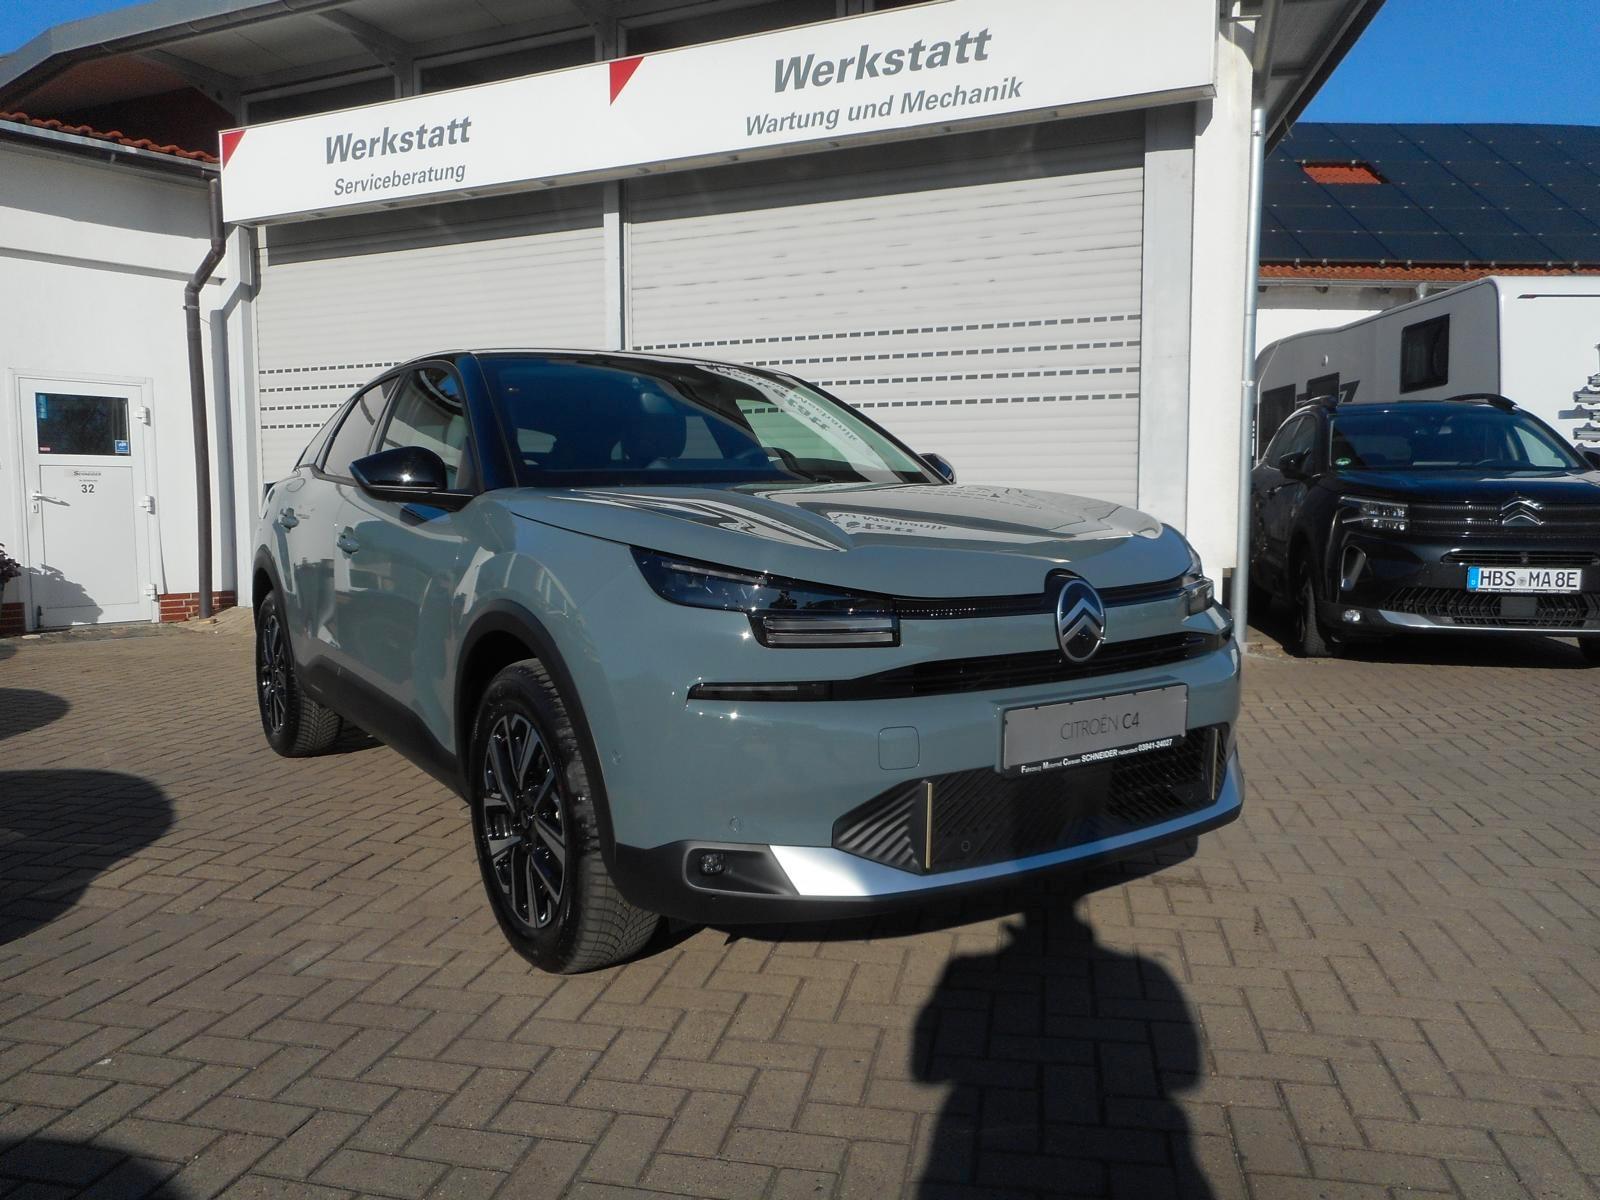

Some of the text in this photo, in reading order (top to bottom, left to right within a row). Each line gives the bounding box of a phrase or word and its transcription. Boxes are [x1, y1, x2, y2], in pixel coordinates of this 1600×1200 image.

[775, 28, 992, 93] Werkstatt
[746, 76, 1023, 137] Wartung und Mechanik
[326, 115, 472, 164] Werkstatt
[334, 163, 466, 195] Serviceberatung
[81, 484, 95, 494] 32
[1480, 570, 1516, 587] HBS
[1528, 571, 1551, 588] MA
[1555, 571, 1578, 588] 8E
[1060, 712, 1140, 740] CITROËN C4
[1081, 748, 1119, 763] SCHNEIDER
